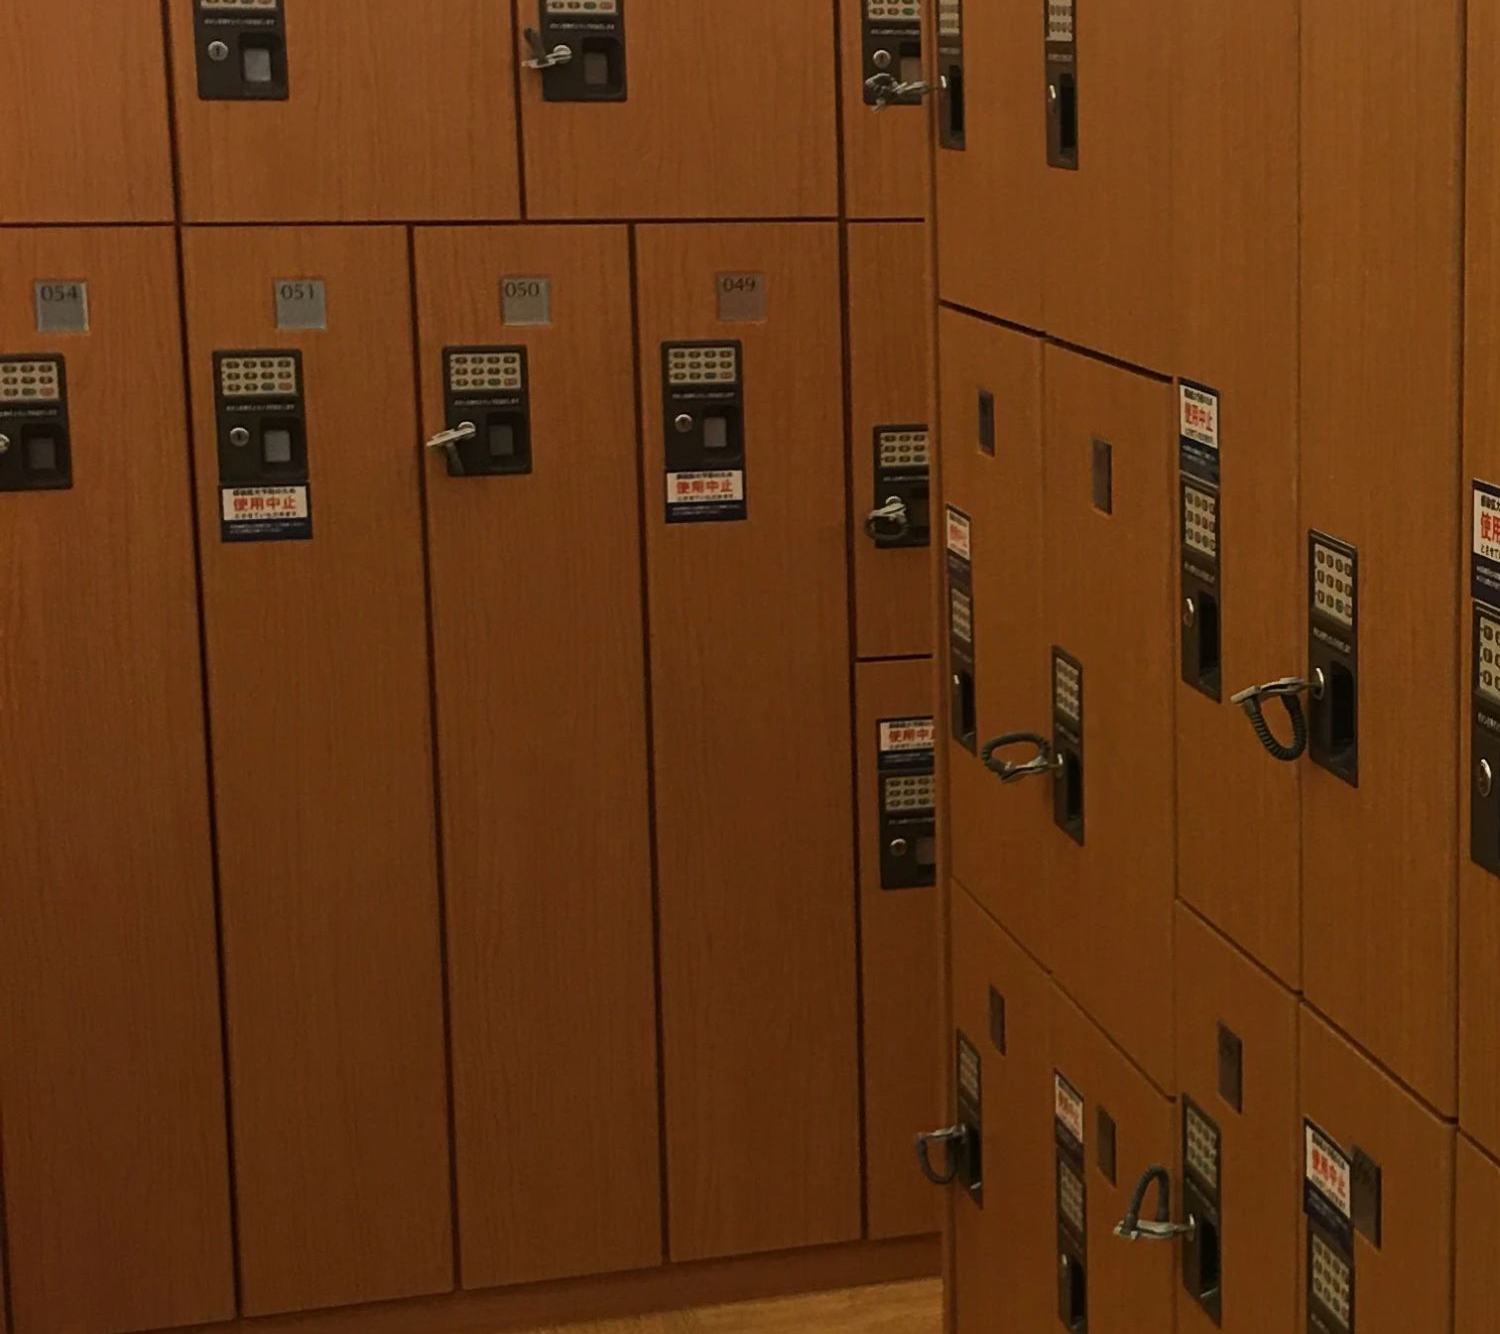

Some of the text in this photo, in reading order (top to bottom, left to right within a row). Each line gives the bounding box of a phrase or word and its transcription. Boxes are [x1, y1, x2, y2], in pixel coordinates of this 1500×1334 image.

[40, 285, 79, 301] 054
[281, 284, 315, 300] 051
[505, 282, 540, 297] 050
[723, 278, 756, 293] 049
[234, 497, 296, 511] 使用中止
